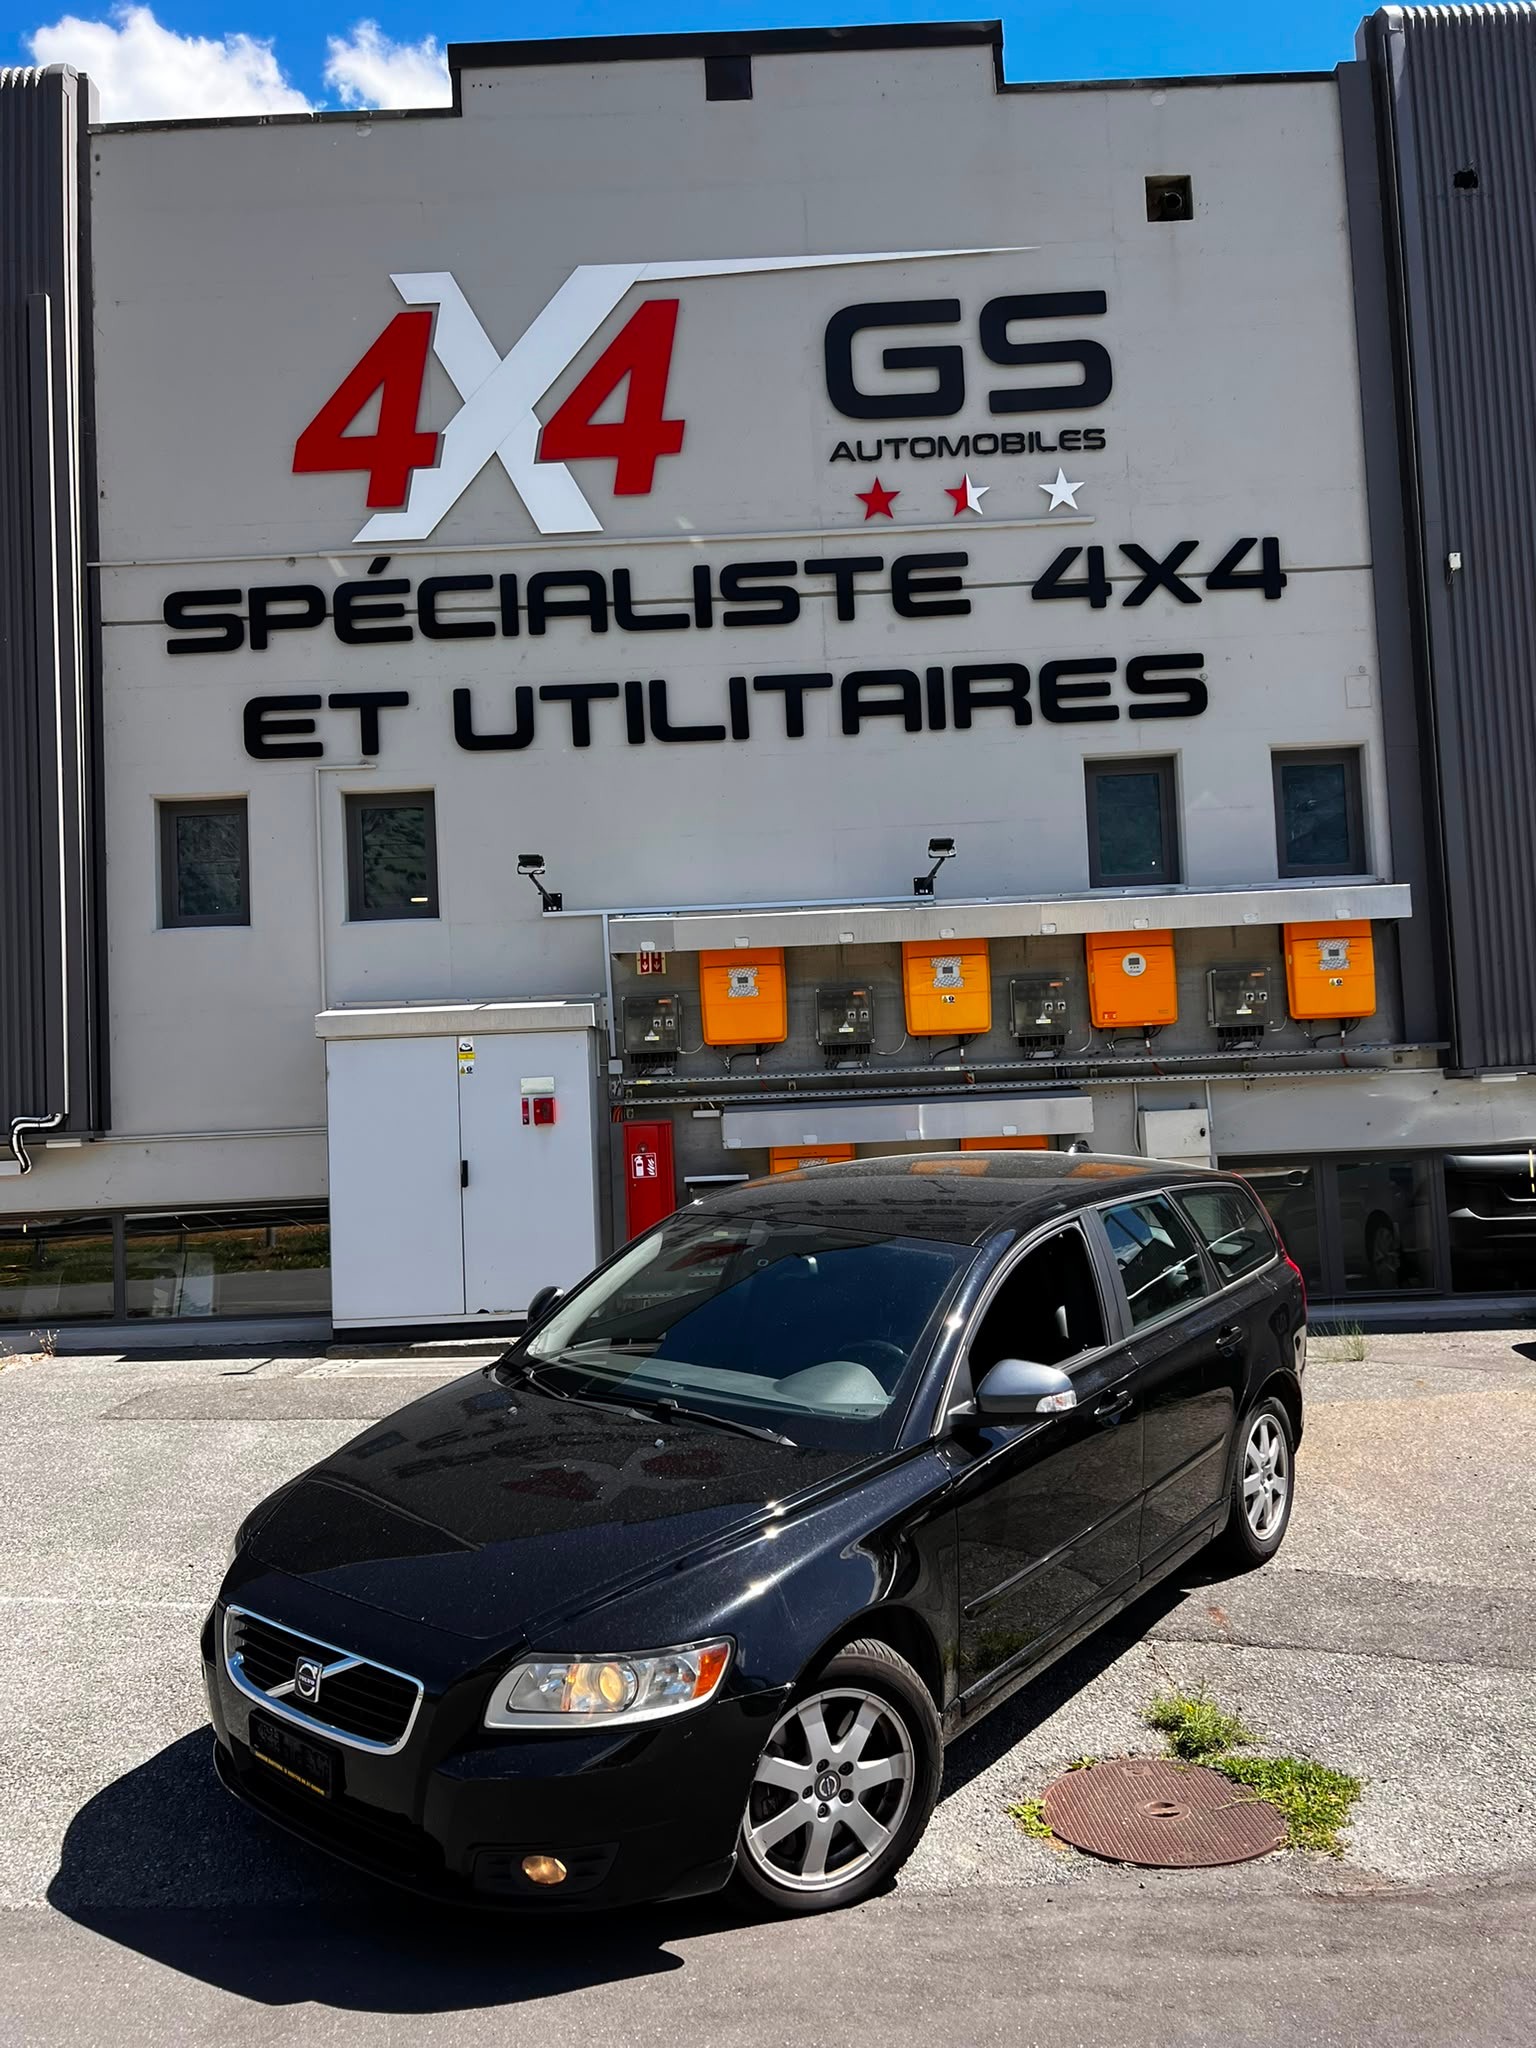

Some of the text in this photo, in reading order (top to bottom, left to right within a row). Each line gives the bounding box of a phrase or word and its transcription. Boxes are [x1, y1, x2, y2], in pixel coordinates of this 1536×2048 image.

[823, 290, 1113, 420] GS
[830, 429, 1106, 463] AUTOMOBILES
[164, 537, 1288, 655] SPÉCIALISTE 4X4
[244, 653, 1208, 760] ET UTILITAIRES
